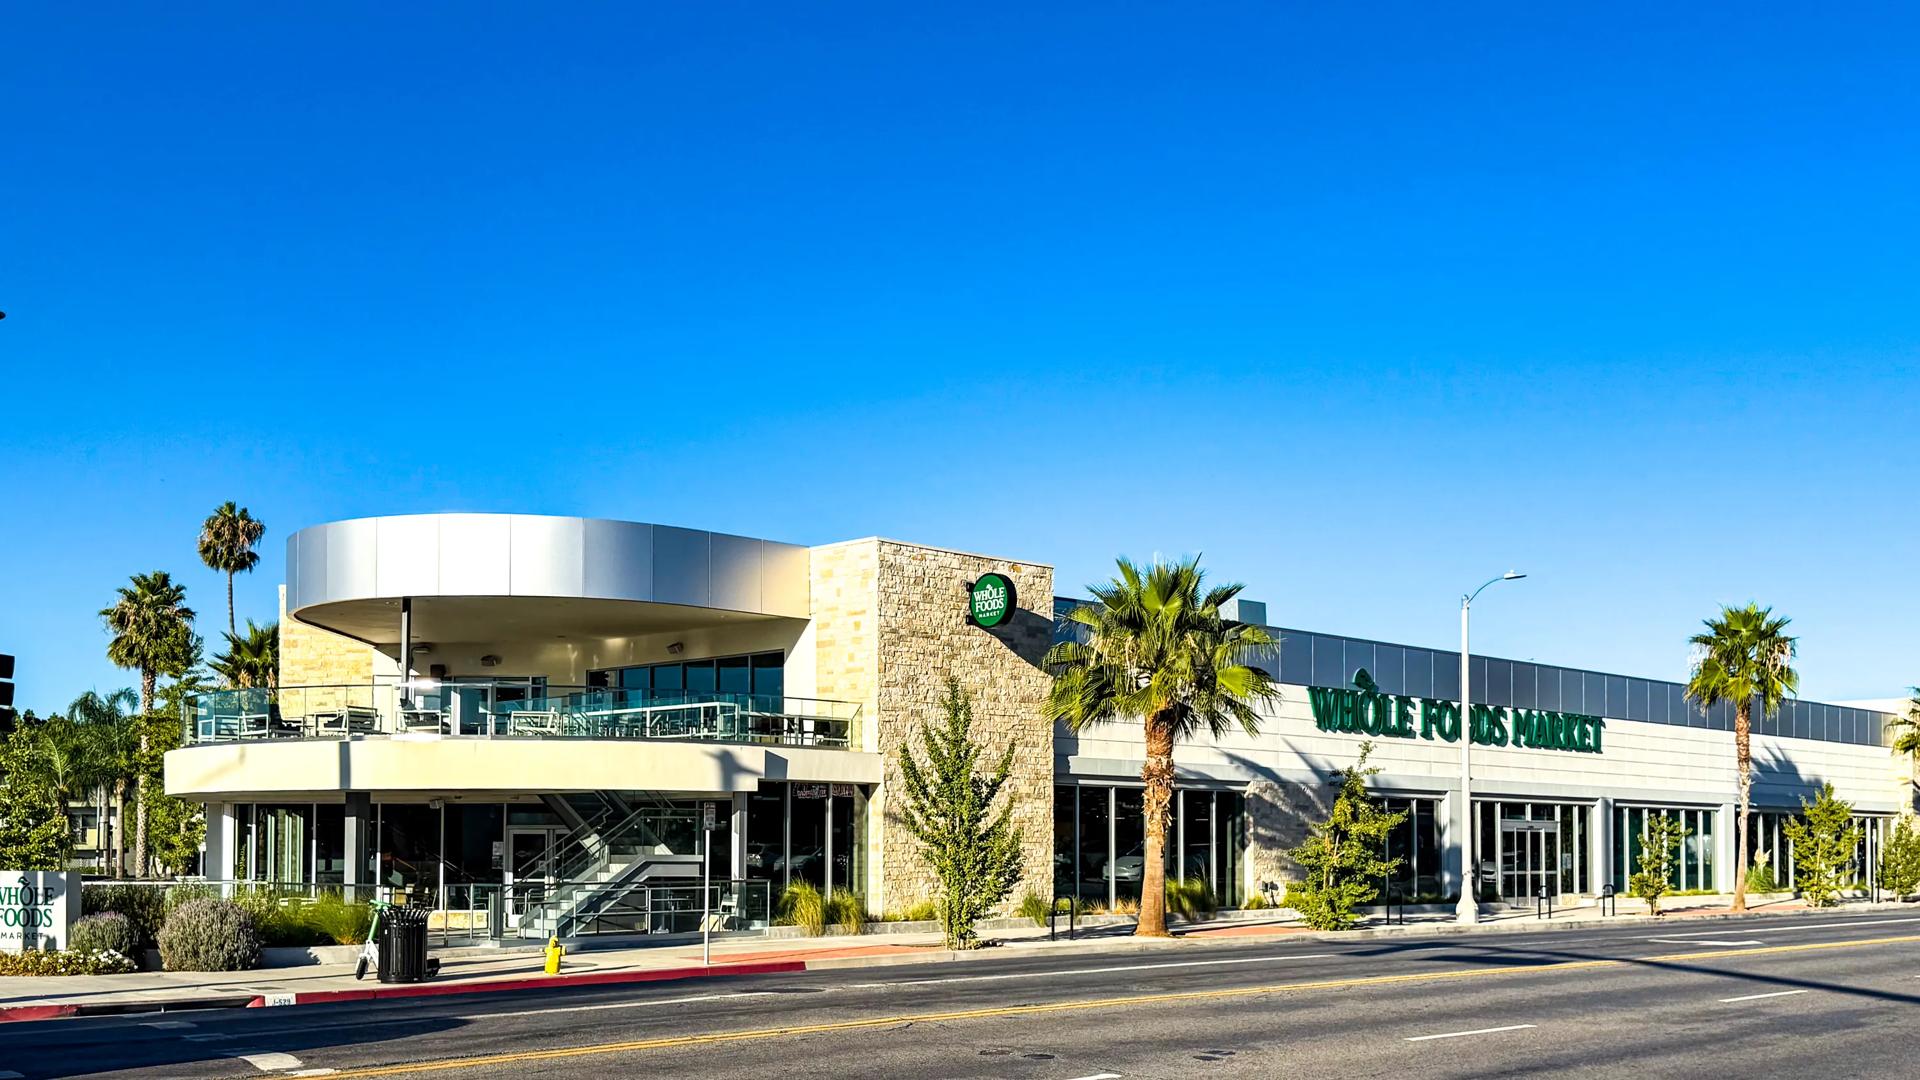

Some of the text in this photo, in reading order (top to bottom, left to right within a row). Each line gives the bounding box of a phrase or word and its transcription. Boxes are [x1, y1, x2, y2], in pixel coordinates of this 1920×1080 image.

[973, 587, 1005, 602] WHOLE
[975, 598, 1004, 613] FOODS
[1307, 686, 1417, 737] WHOLE
[1511, 708, 1606, 754] MARKET
[0, 932, 44, 940] MARKET
